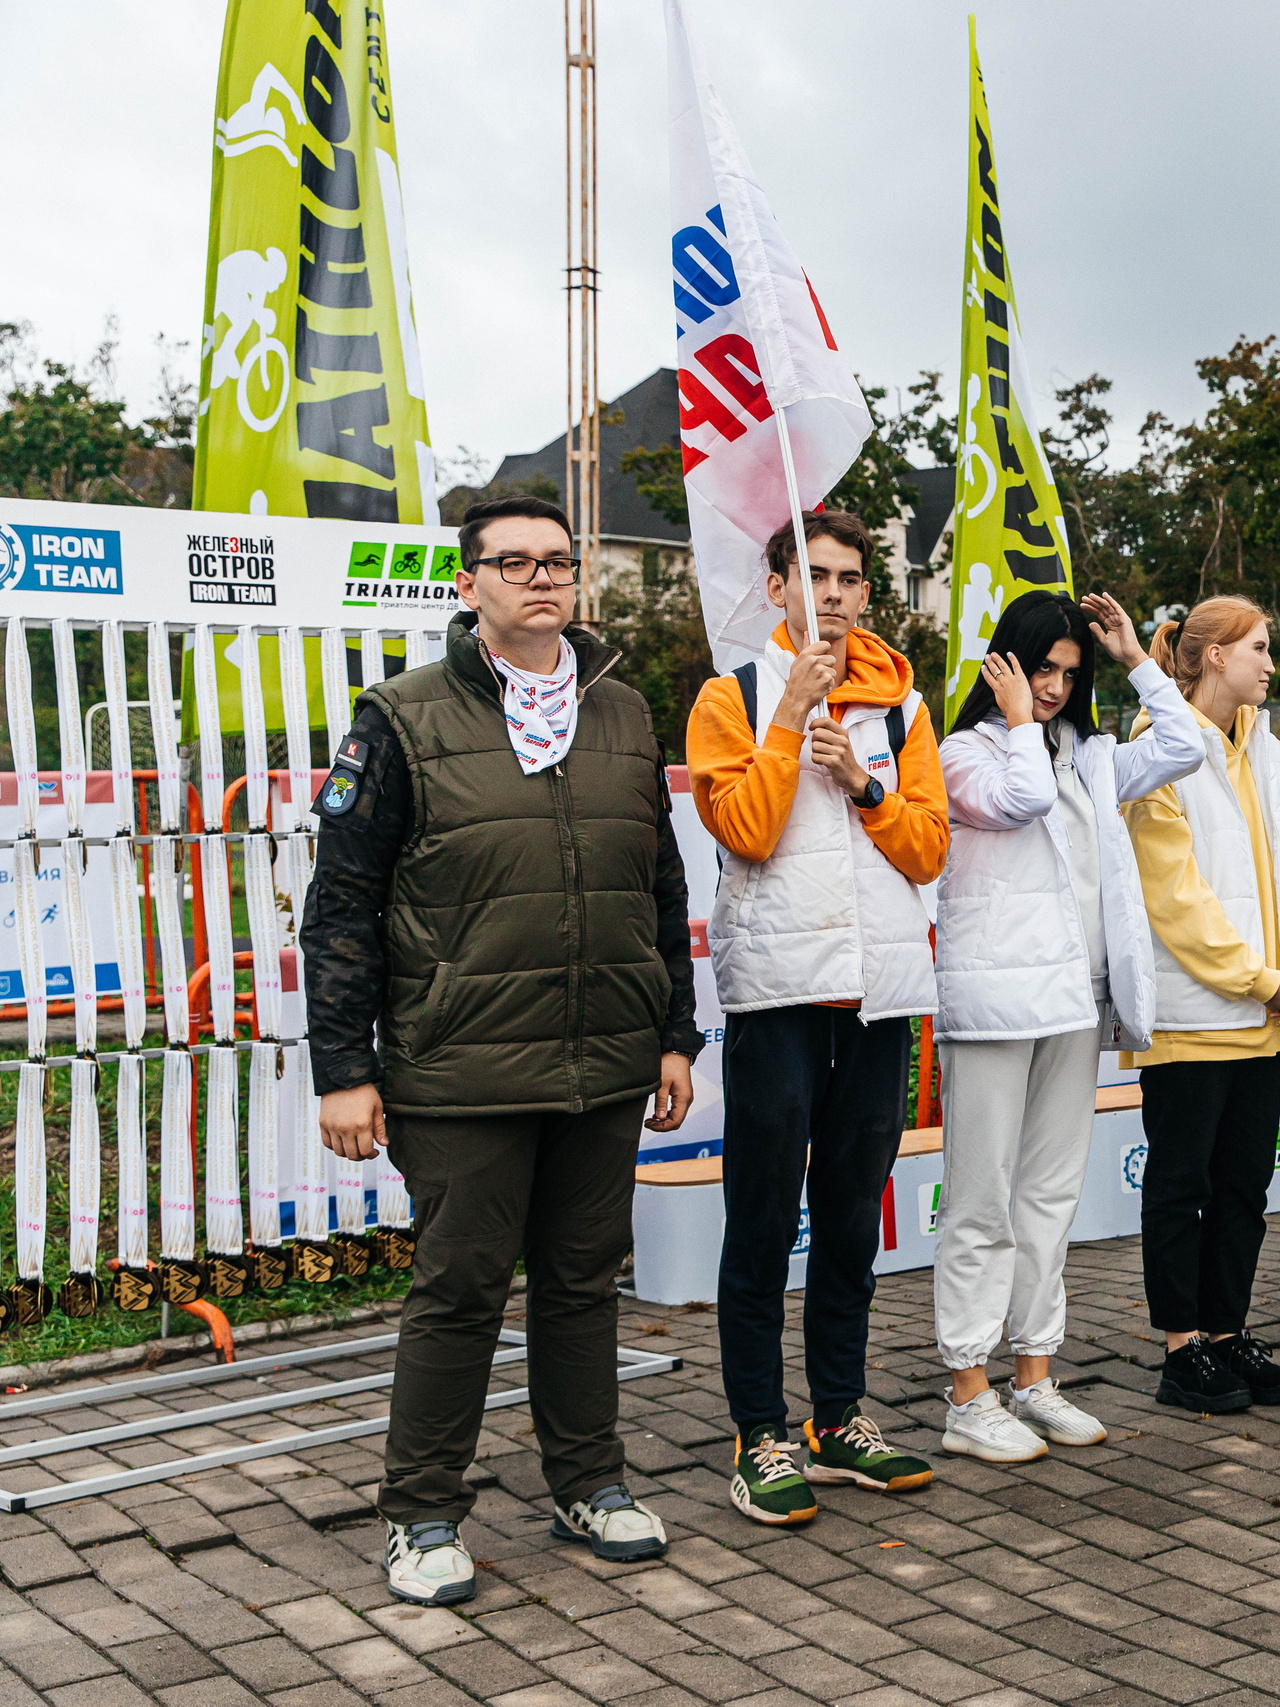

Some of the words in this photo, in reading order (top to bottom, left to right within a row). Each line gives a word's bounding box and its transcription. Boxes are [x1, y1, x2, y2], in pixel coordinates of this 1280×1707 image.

[32, 533, 105, 560] IRON
[33, 563, 118, 589] TEAM
[188, 553, 275, 580] ОСТРОВ
[193, 583, 229, 603] IRON
[231, 585, 273, 604] TEAM
[345, 582, 460, 600] TRIATHLON
